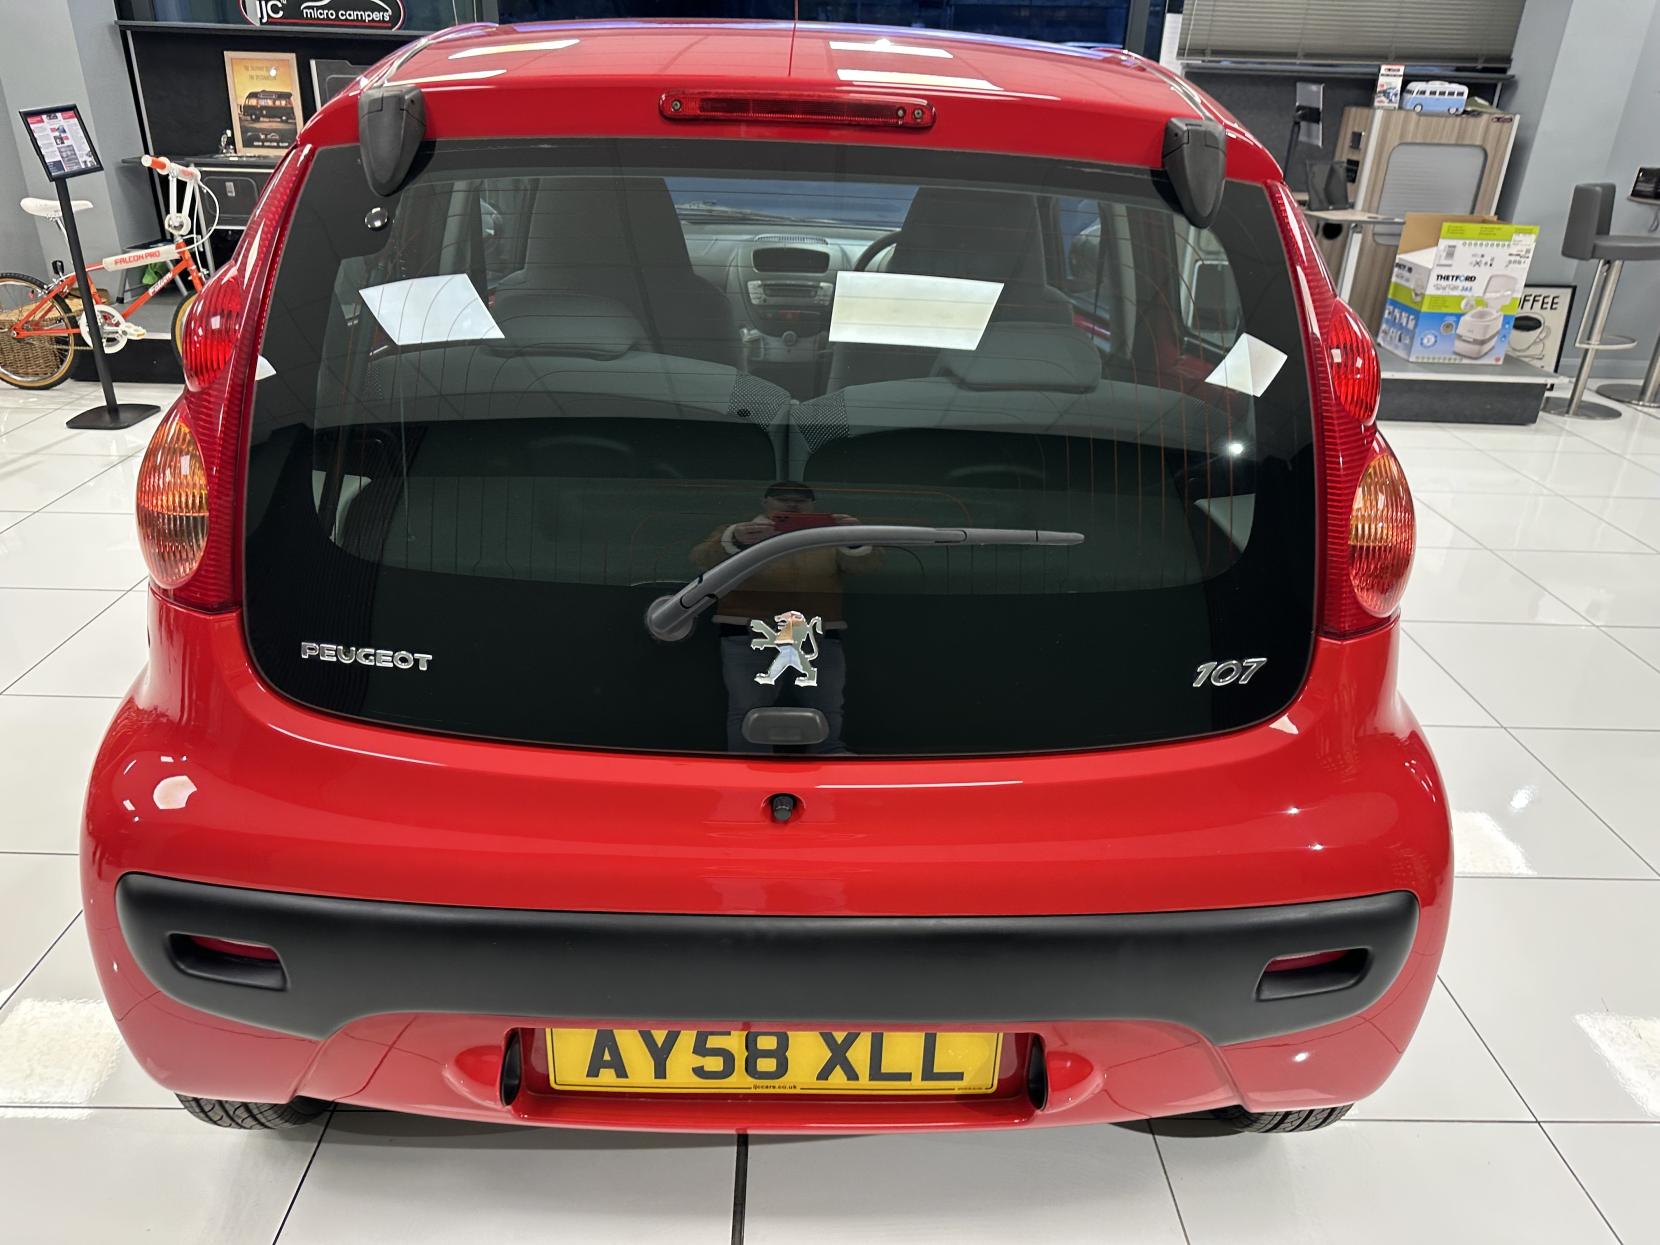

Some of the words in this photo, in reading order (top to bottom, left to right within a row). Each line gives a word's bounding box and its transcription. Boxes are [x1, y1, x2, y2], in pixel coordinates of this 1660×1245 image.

[303, 8, 336, 19] micro
[338, 10, 390, 22] campers
[114, 254, 144, 265] FALCON
[145, 250, 160, 260] PRO
[1436, 274, 1476, 282] THETFORD
[1518, 293, 1560, 311] FFEE
[301, 641, 433, 671] PEUGEOT
[1192, 657, 1268, 688] 107
[585, 1028, 790, 1081] AY58
[815, 1031, 965, 1082] XLL
